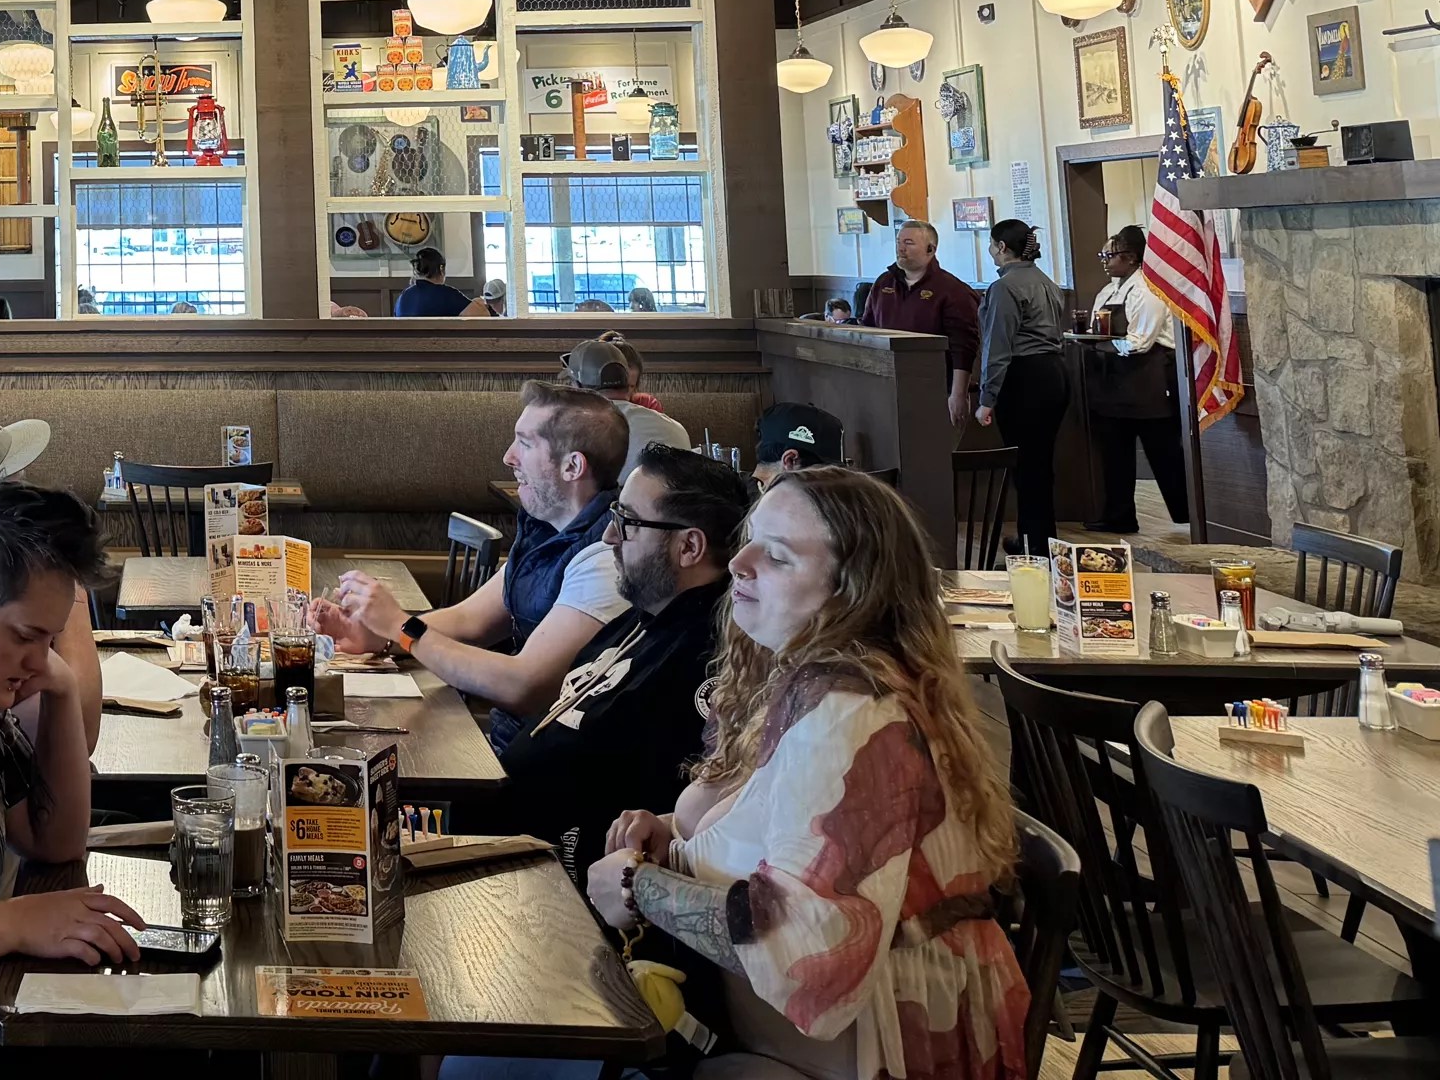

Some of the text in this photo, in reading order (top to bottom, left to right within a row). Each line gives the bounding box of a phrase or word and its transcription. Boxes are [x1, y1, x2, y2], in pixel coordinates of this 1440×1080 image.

[532, 74, 558, 90] Pick
[618, 80, 630, 88] For
[545, 89, 562, 108] 6
[1080, 580, 1091, 593] $6
[290, 819, 305, 840] $6
[272, 990, 410, 999] JOIN TODA
[296, 1000, 402, 1014] Rewards
